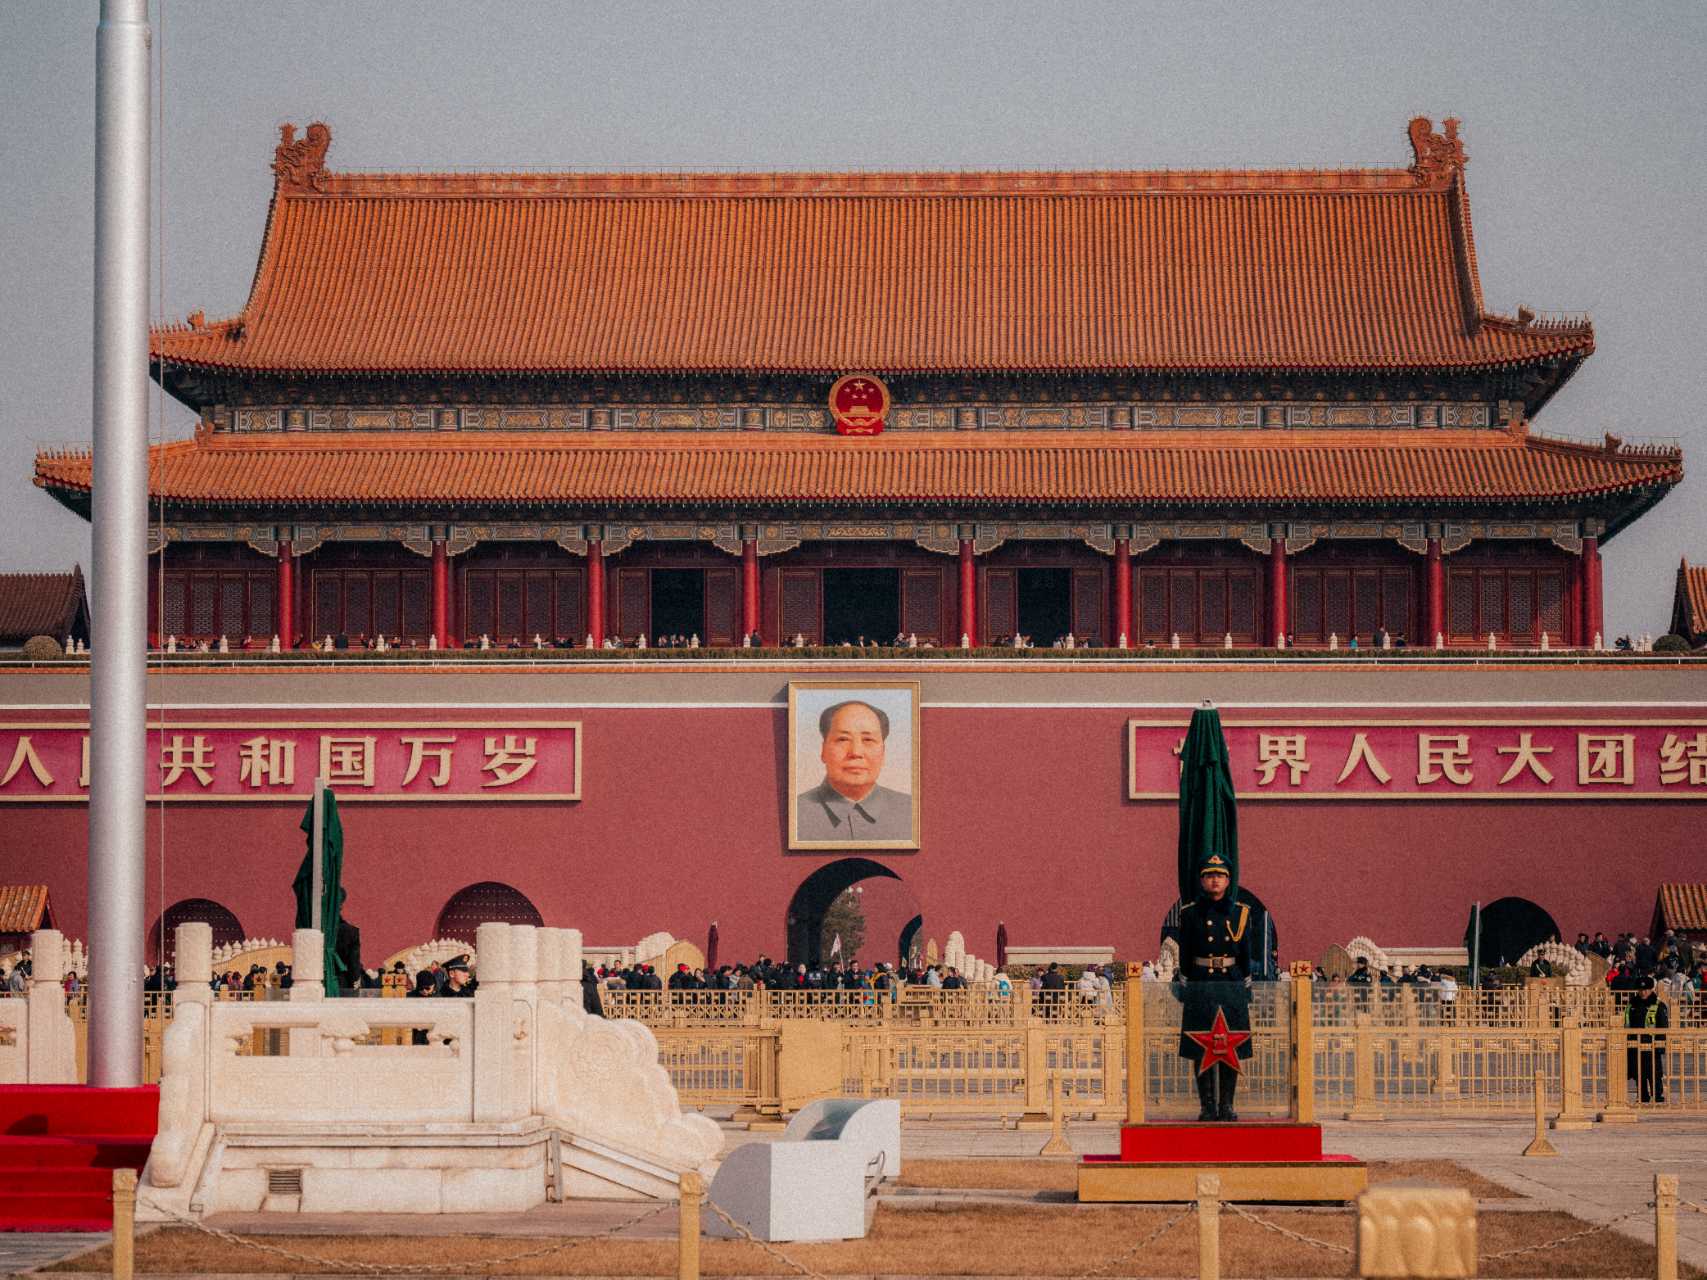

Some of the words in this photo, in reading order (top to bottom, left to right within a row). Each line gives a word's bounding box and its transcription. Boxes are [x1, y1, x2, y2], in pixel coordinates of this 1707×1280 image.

[0, 736, 538, 787] 人共和国万岁
[1173, 733, 1707, 785] 界人民大团结
